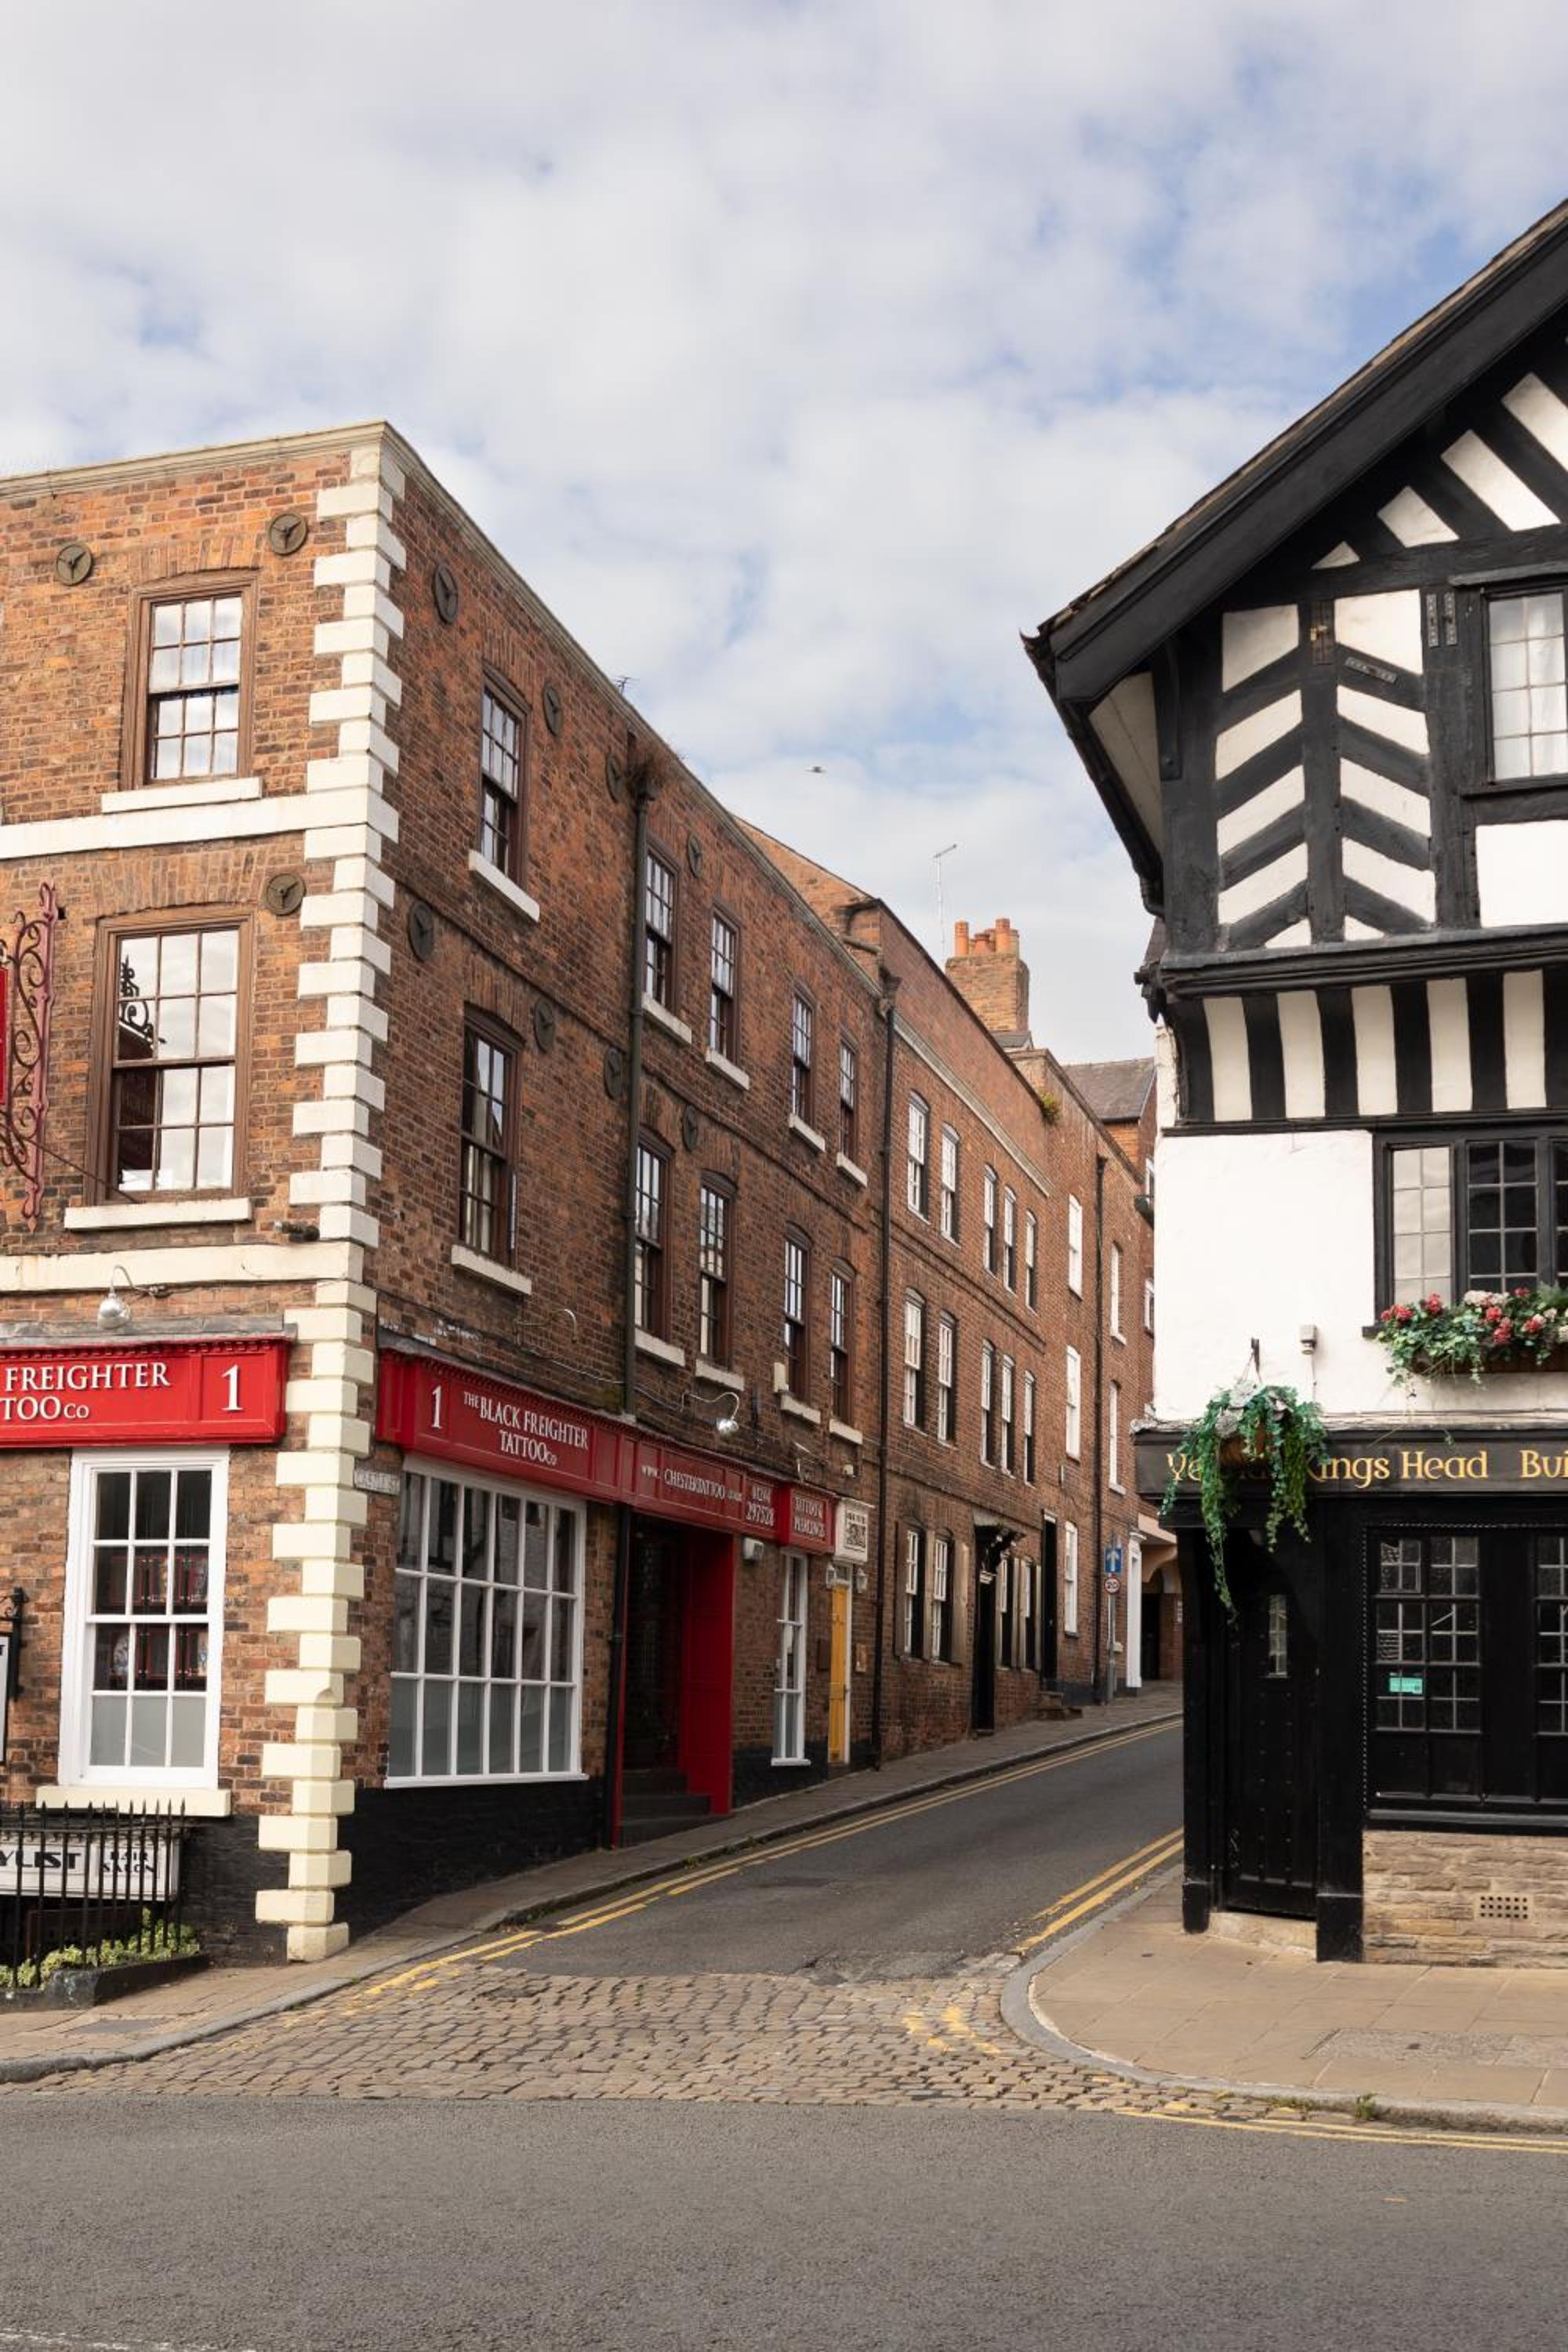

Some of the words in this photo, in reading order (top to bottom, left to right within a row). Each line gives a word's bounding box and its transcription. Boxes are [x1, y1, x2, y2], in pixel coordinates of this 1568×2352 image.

[5, 1362, 170, 1392] FREIGHTER
[221, 1364, 243, 1411] 1
[432, 1385, 443, 1429] 1
[464, 1392, 479, 1409] THE
[480, 1397, 521, 1429] BLACK
[524, 1410, 588, 1450] FREIGHTER
[499, 1429, 546, 1462] TATTOO
[1401, 1450, 1489, 1479] Head
[101, 1862, 155, 1872] SAON
